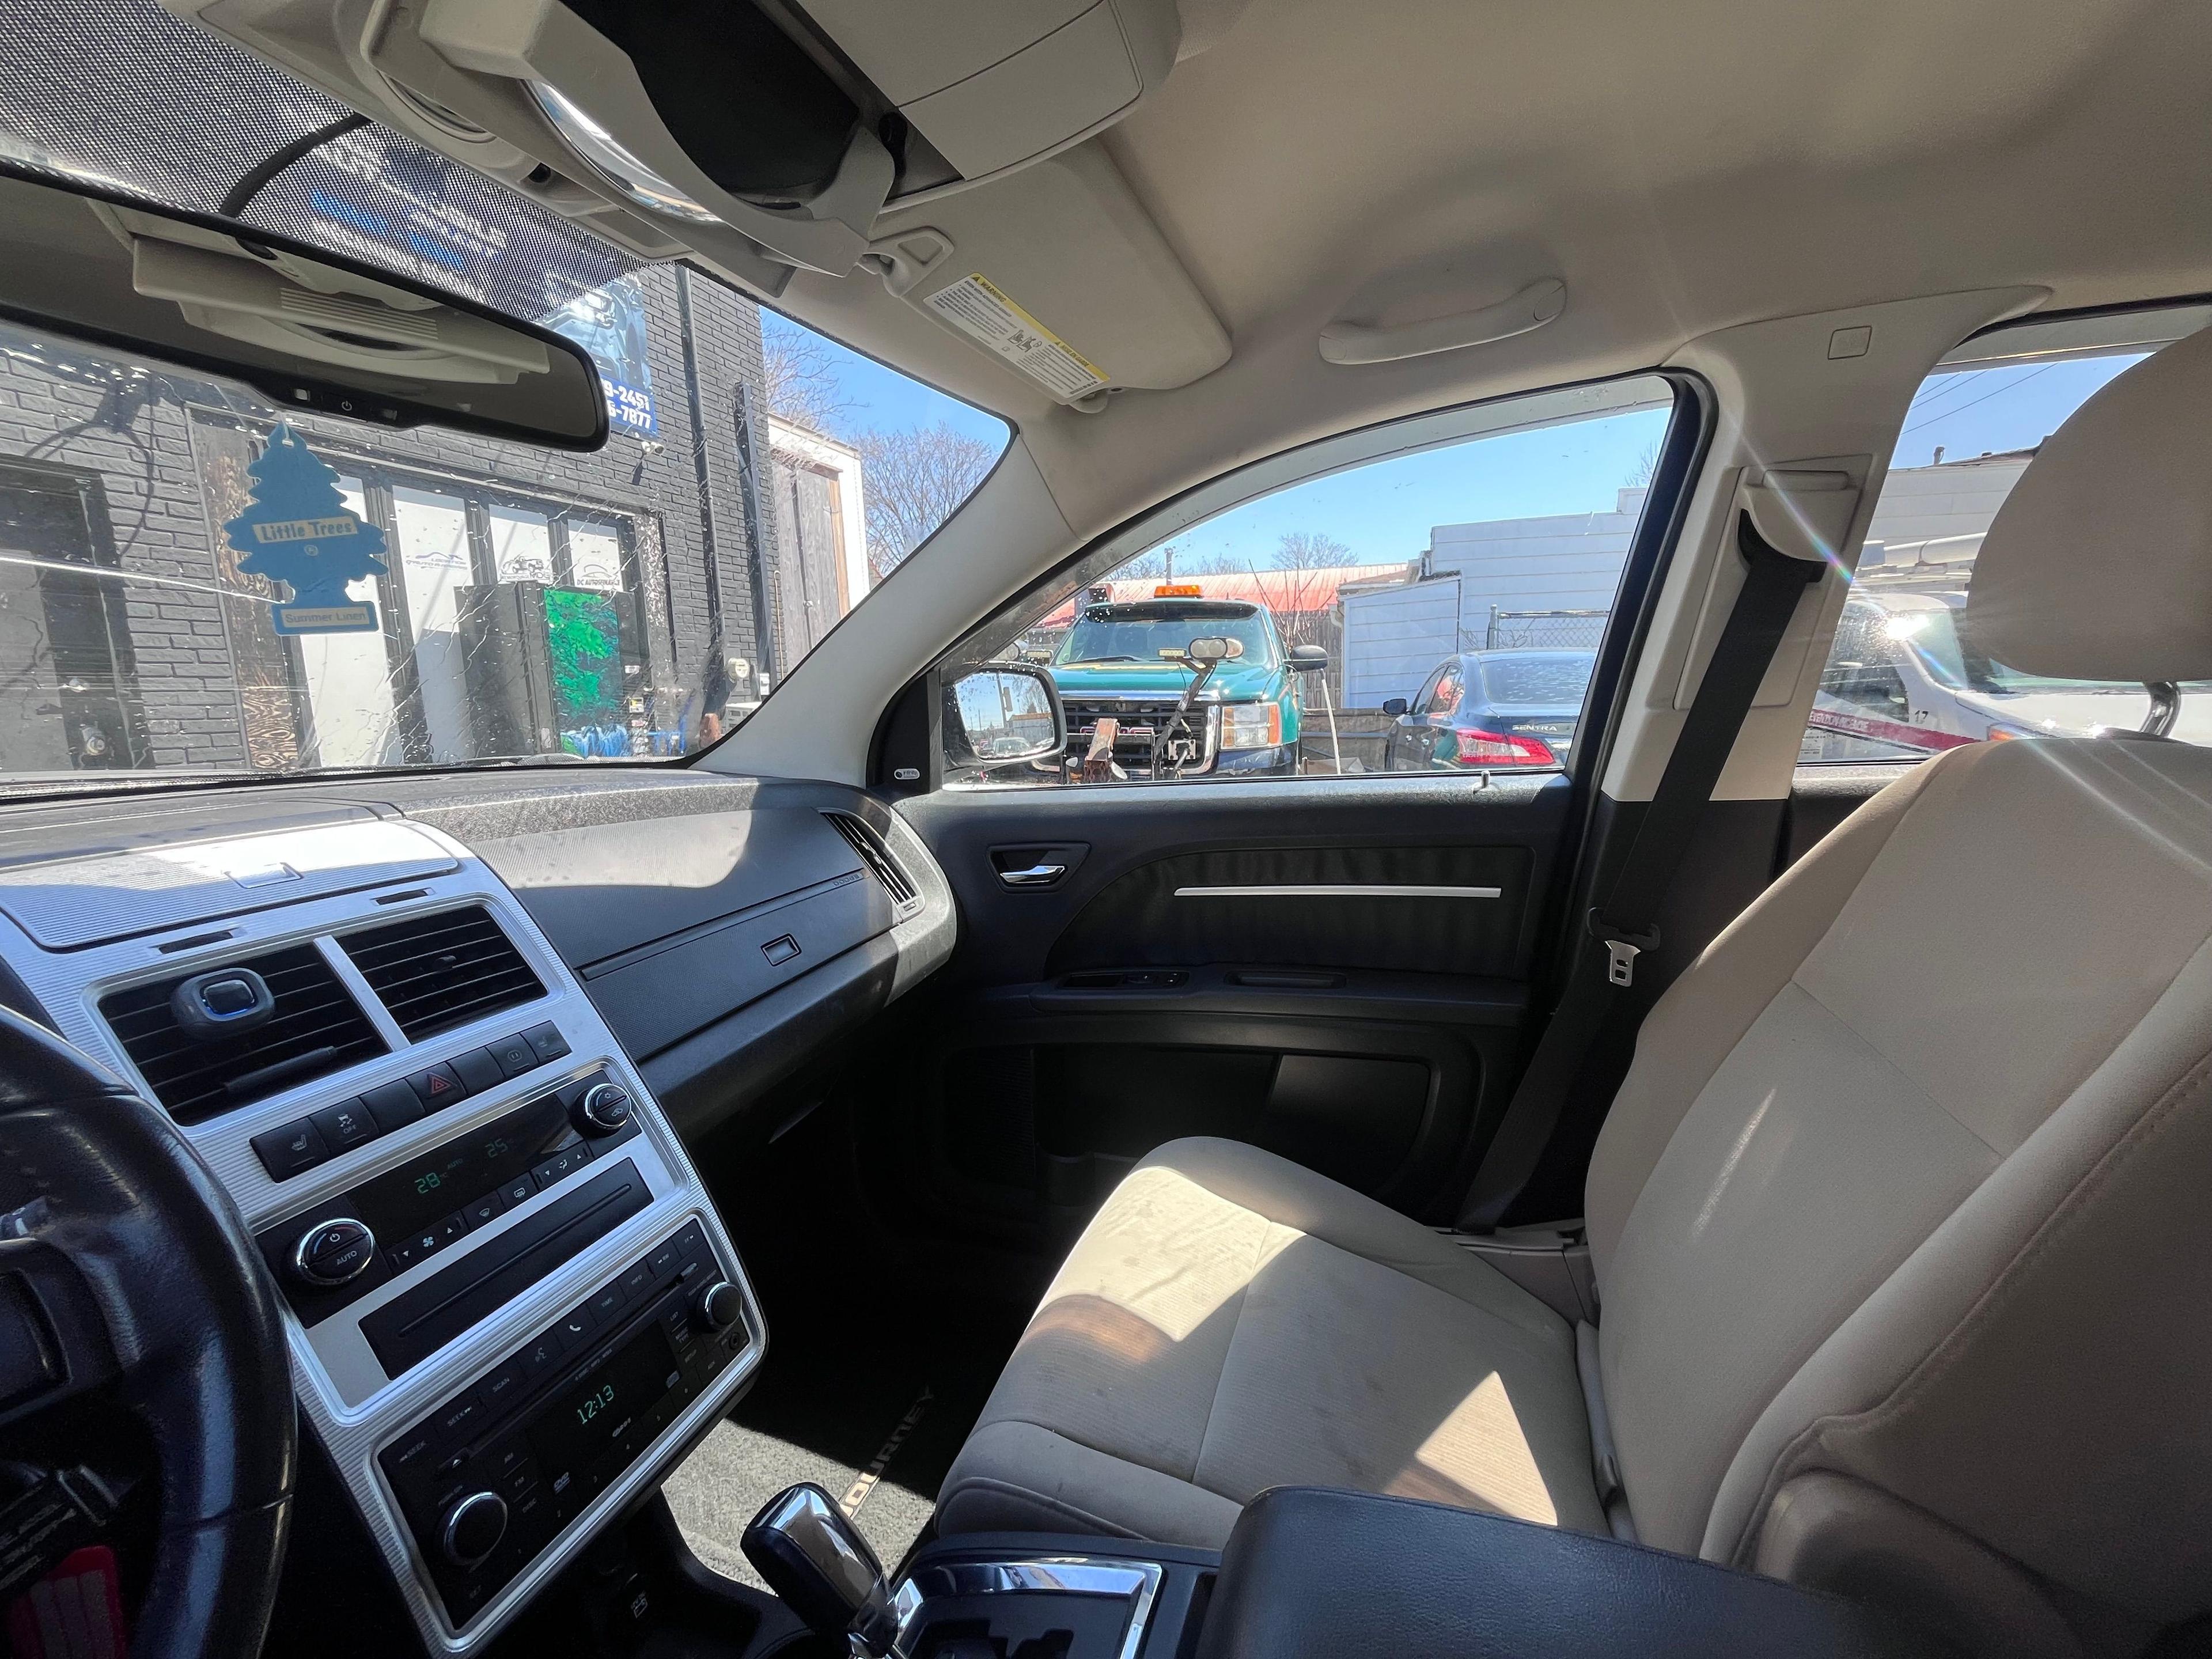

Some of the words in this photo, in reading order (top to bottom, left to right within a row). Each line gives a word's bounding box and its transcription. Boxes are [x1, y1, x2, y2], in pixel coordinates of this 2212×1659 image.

[980, 282, 1006, 302] WARNING
[600, 377, 650, 411] 9-2451
[261, 523, 305, 541] Little
[308, 521, 351, 536] Trees
[285, 613, 332, 623] Summer
[336, 612, 366, 622] Linen
[484, 1138, 509, 1158] 25
[447, 1158, 464, 1170] AUTO
[414, 1172, 442, 1194] 28
[336, 1250, 357, 1266] AUTO
[631, 1274, 643, 1285] INFO
[601, 1297, 613, 1308] TIME
[493, 1377, 510, 1393] SCAN
[577, 1384, 615, 1425] 12:13
[447, 1411, 465, 1427] SEEK
[406, 1440, 427, 1458] SEEK
